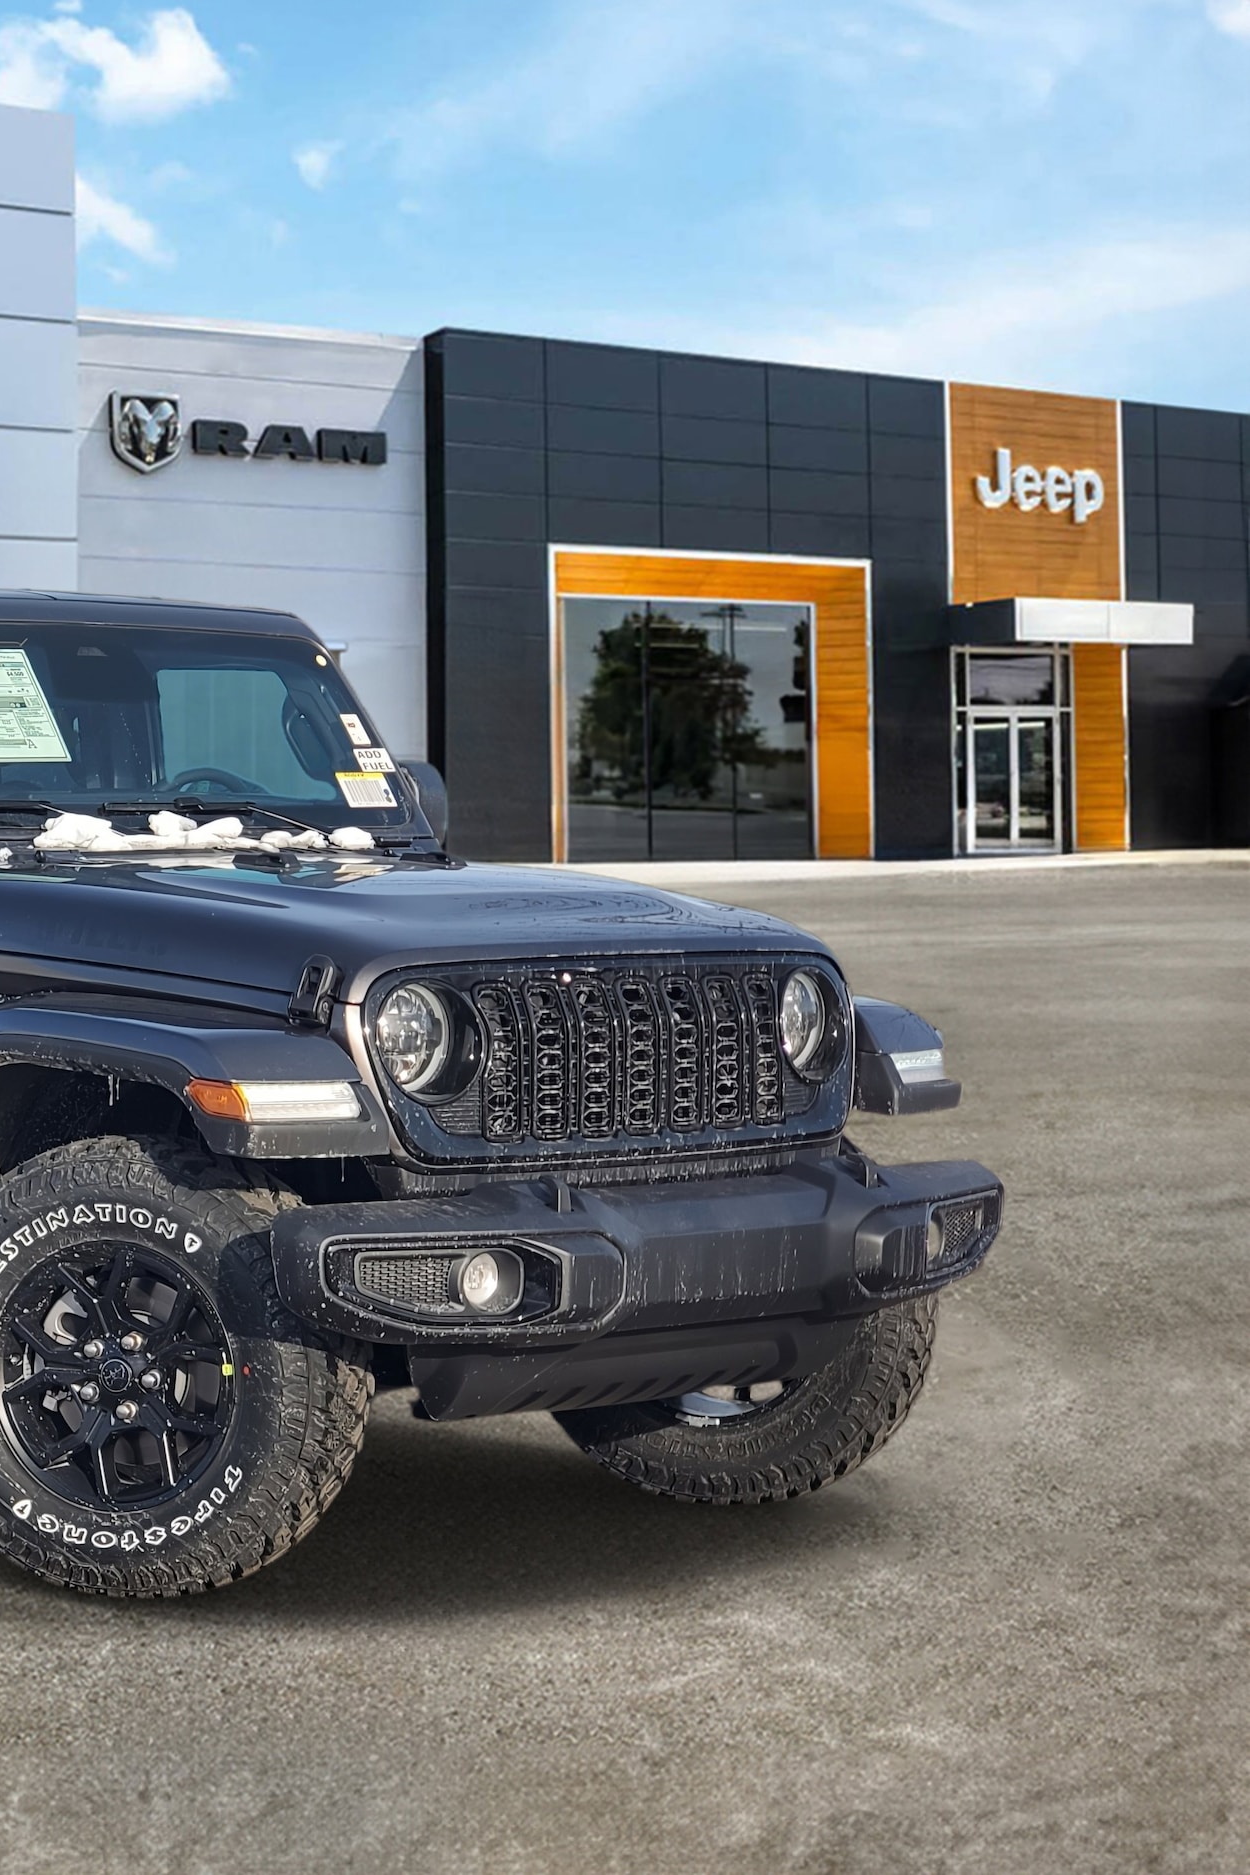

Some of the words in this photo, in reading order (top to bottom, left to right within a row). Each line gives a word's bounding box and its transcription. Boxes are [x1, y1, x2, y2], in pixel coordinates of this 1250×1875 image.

[191, 418, 388, 466] RAM
[975, 447, 1105, 525] Jeep
[357, 750, 382, 759] ADD
[362, 762, 394, 771] FUEL
